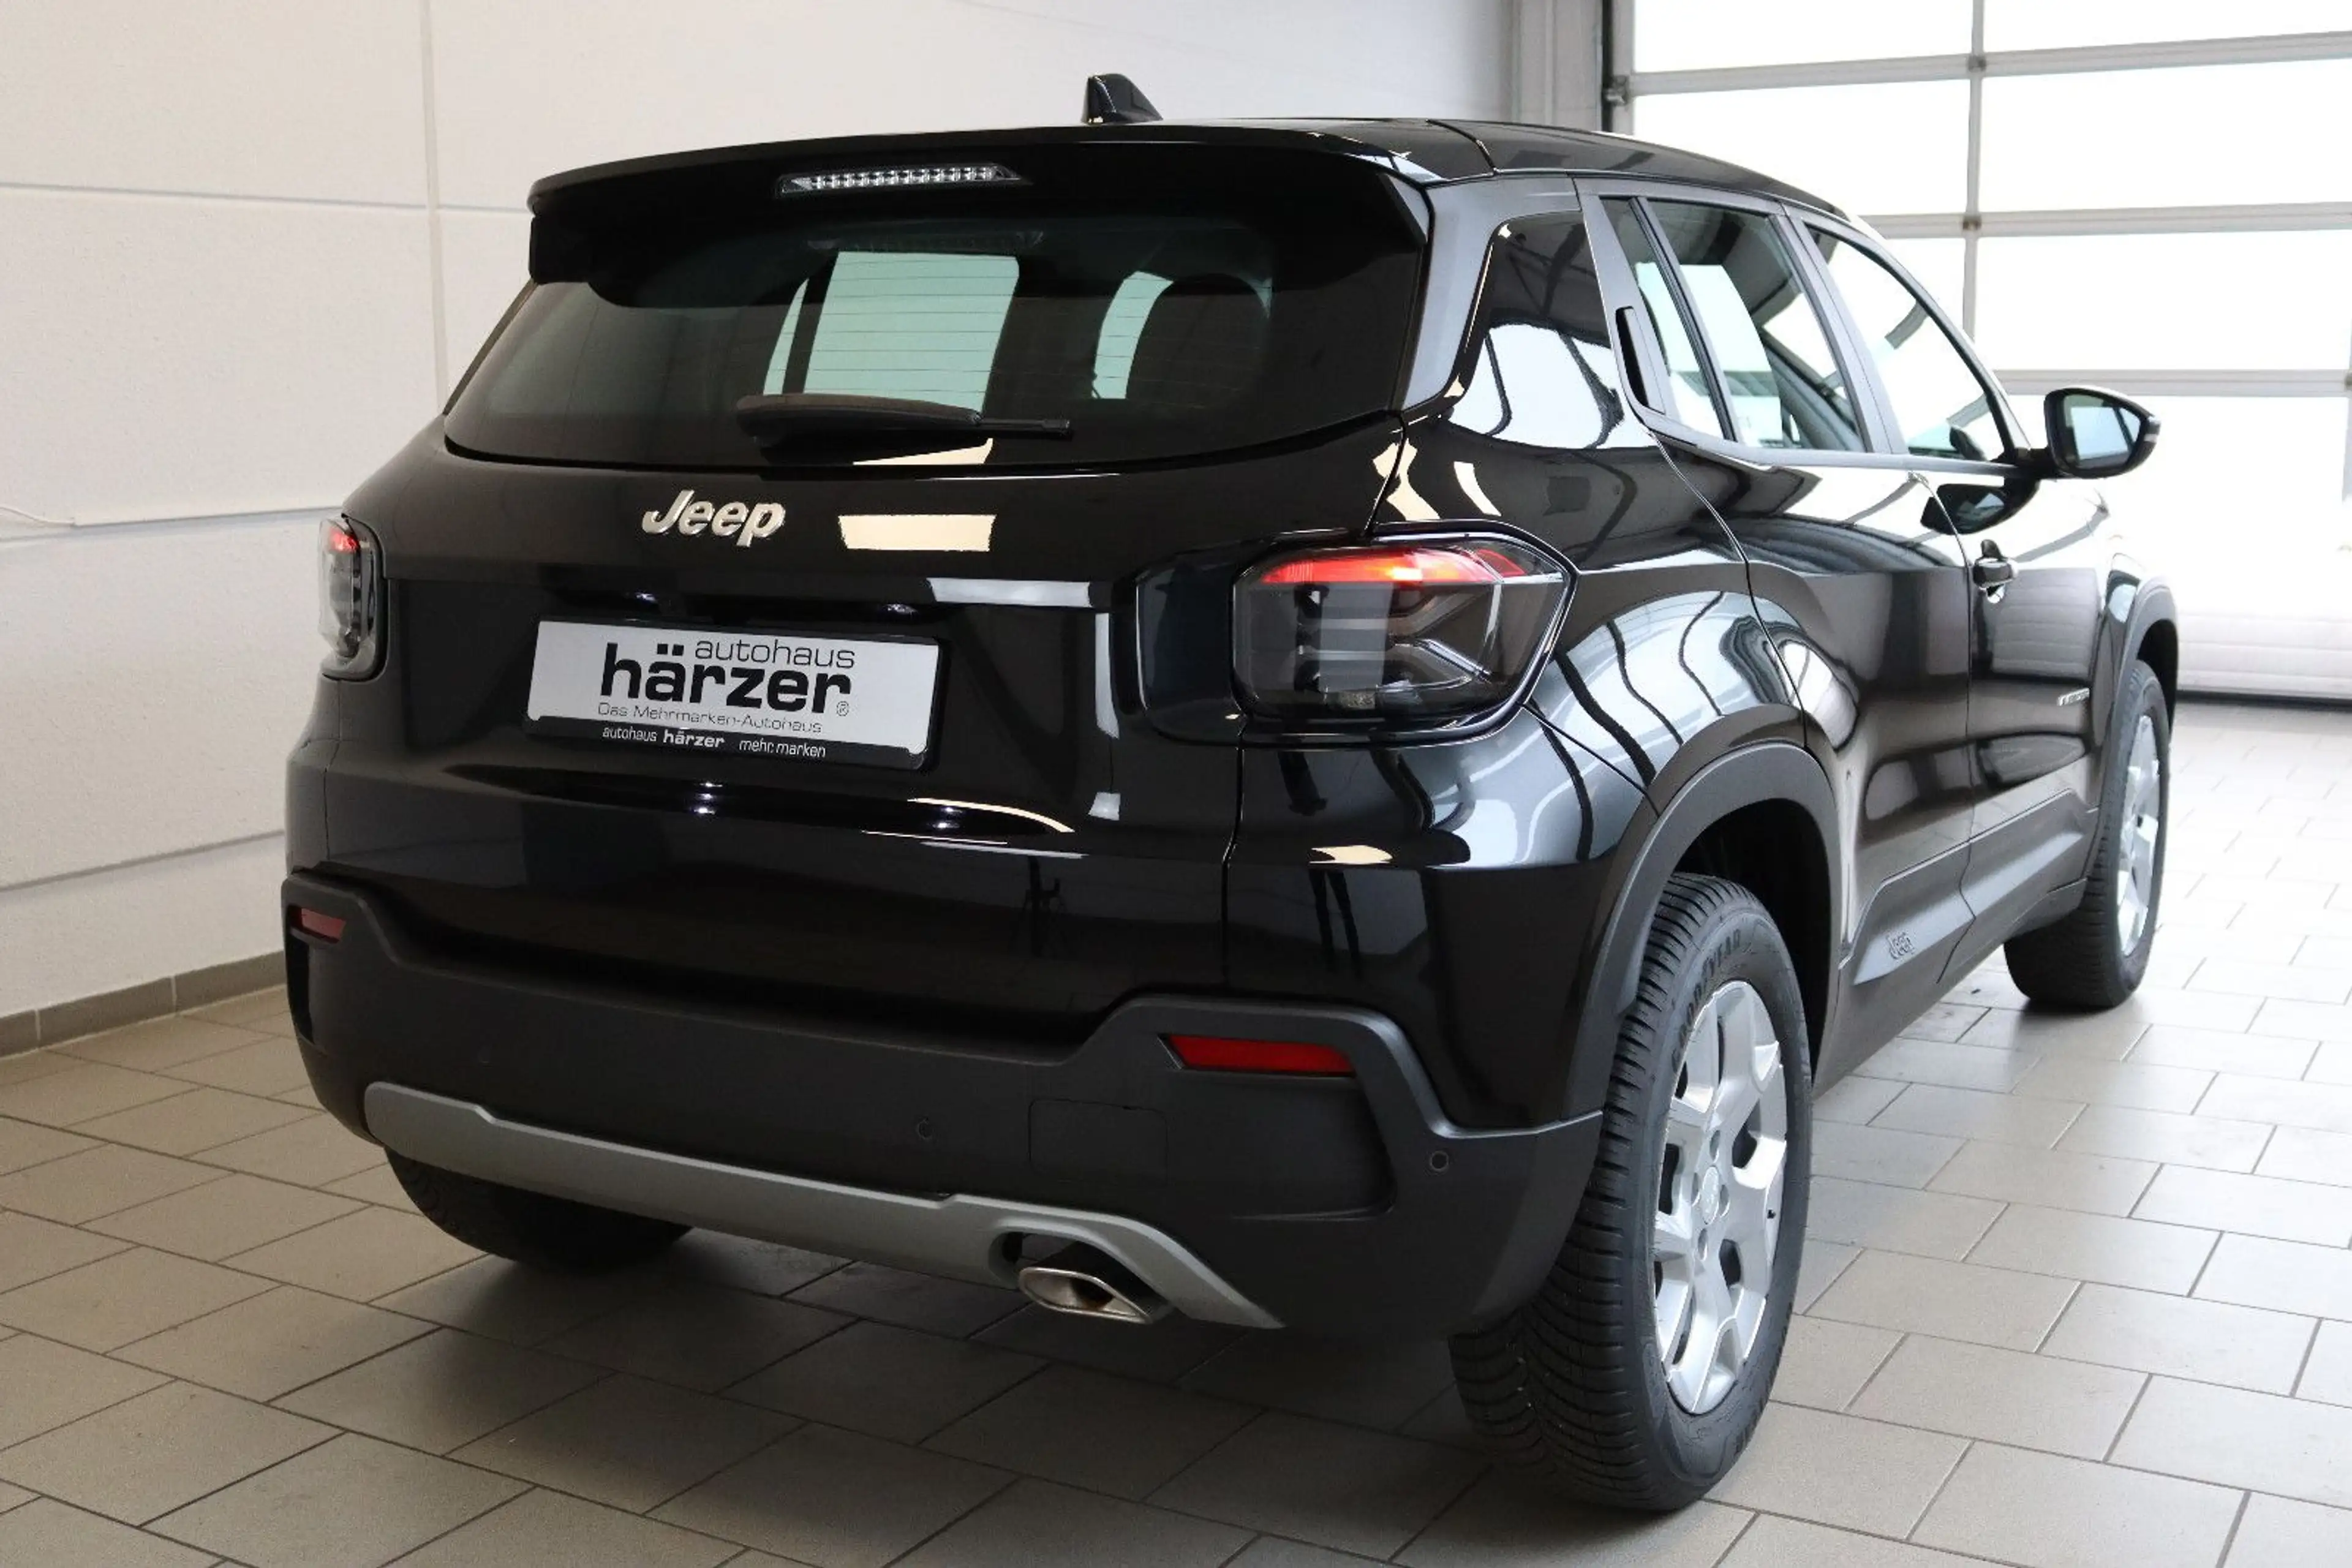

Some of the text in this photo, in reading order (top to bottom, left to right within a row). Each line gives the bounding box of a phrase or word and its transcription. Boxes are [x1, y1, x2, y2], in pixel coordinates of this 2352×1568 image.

[641, 489, 786, 548] Jeep
[695, 638, 856, 668] autohaus
[598, 702, 823, 733] Das Mehrmarken-Autohaus
[602, 726, 657, 742] autohaus
[663, 728, 725, 748] härzer
